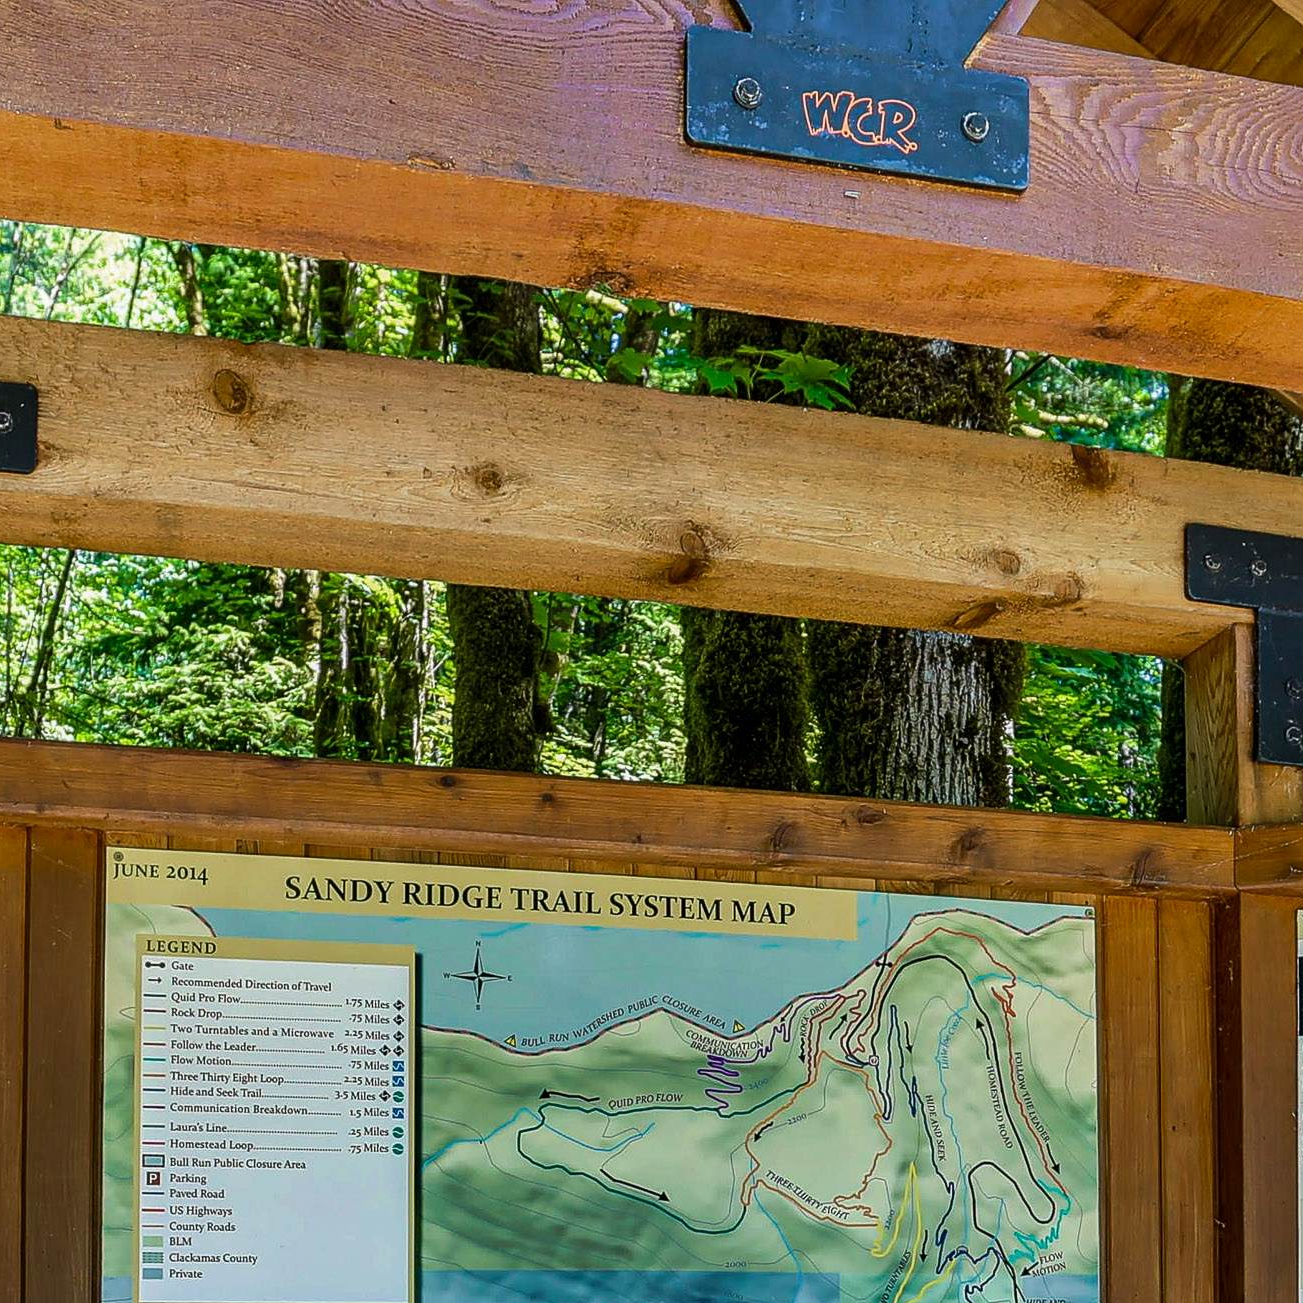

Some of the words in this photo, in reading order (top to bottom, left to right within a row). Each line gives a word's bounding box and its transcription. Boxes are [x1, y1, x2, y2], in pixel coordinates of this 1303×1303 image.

[112, 860, 159, 879] JUNE
[165, 864, 209, 887] 2014
[285, 875, 395, 904] SANDY
[401, 881, 502, 909] RIDGE
[509, 887, 602, 914] TRAIL
[609, 892, 723, 921] SYSTEM
[730, 899, 795, 925] MAP
[144, 939, 219, 957] LEGEND
[169, 1157, 189, 1167] Bull
[191, 1157, 211, 1167] Run
[213, 1157, 245, 1168] Public
[245, 1158, 283, 1169] Closure
[283, 1159, 306, 1169] Area
[169, 1173, 207, 1187] Parking
[169, 1188, 198, 1198] Paved
[200, 1188, 225, 1199] Road
[169, 1205, 184, 1215] US
[186, 1205, 233, 1218] Highways
[169, 1221, 205, 1234] County
[206, 1221, 236, 1232] Roads
[169, 1236, 192, 1246] BLM
[168, 1252, 221, 1262] Clackamas
[222, 1253, 258, 1266] County
[169, 1268, 203, 1278] Private
